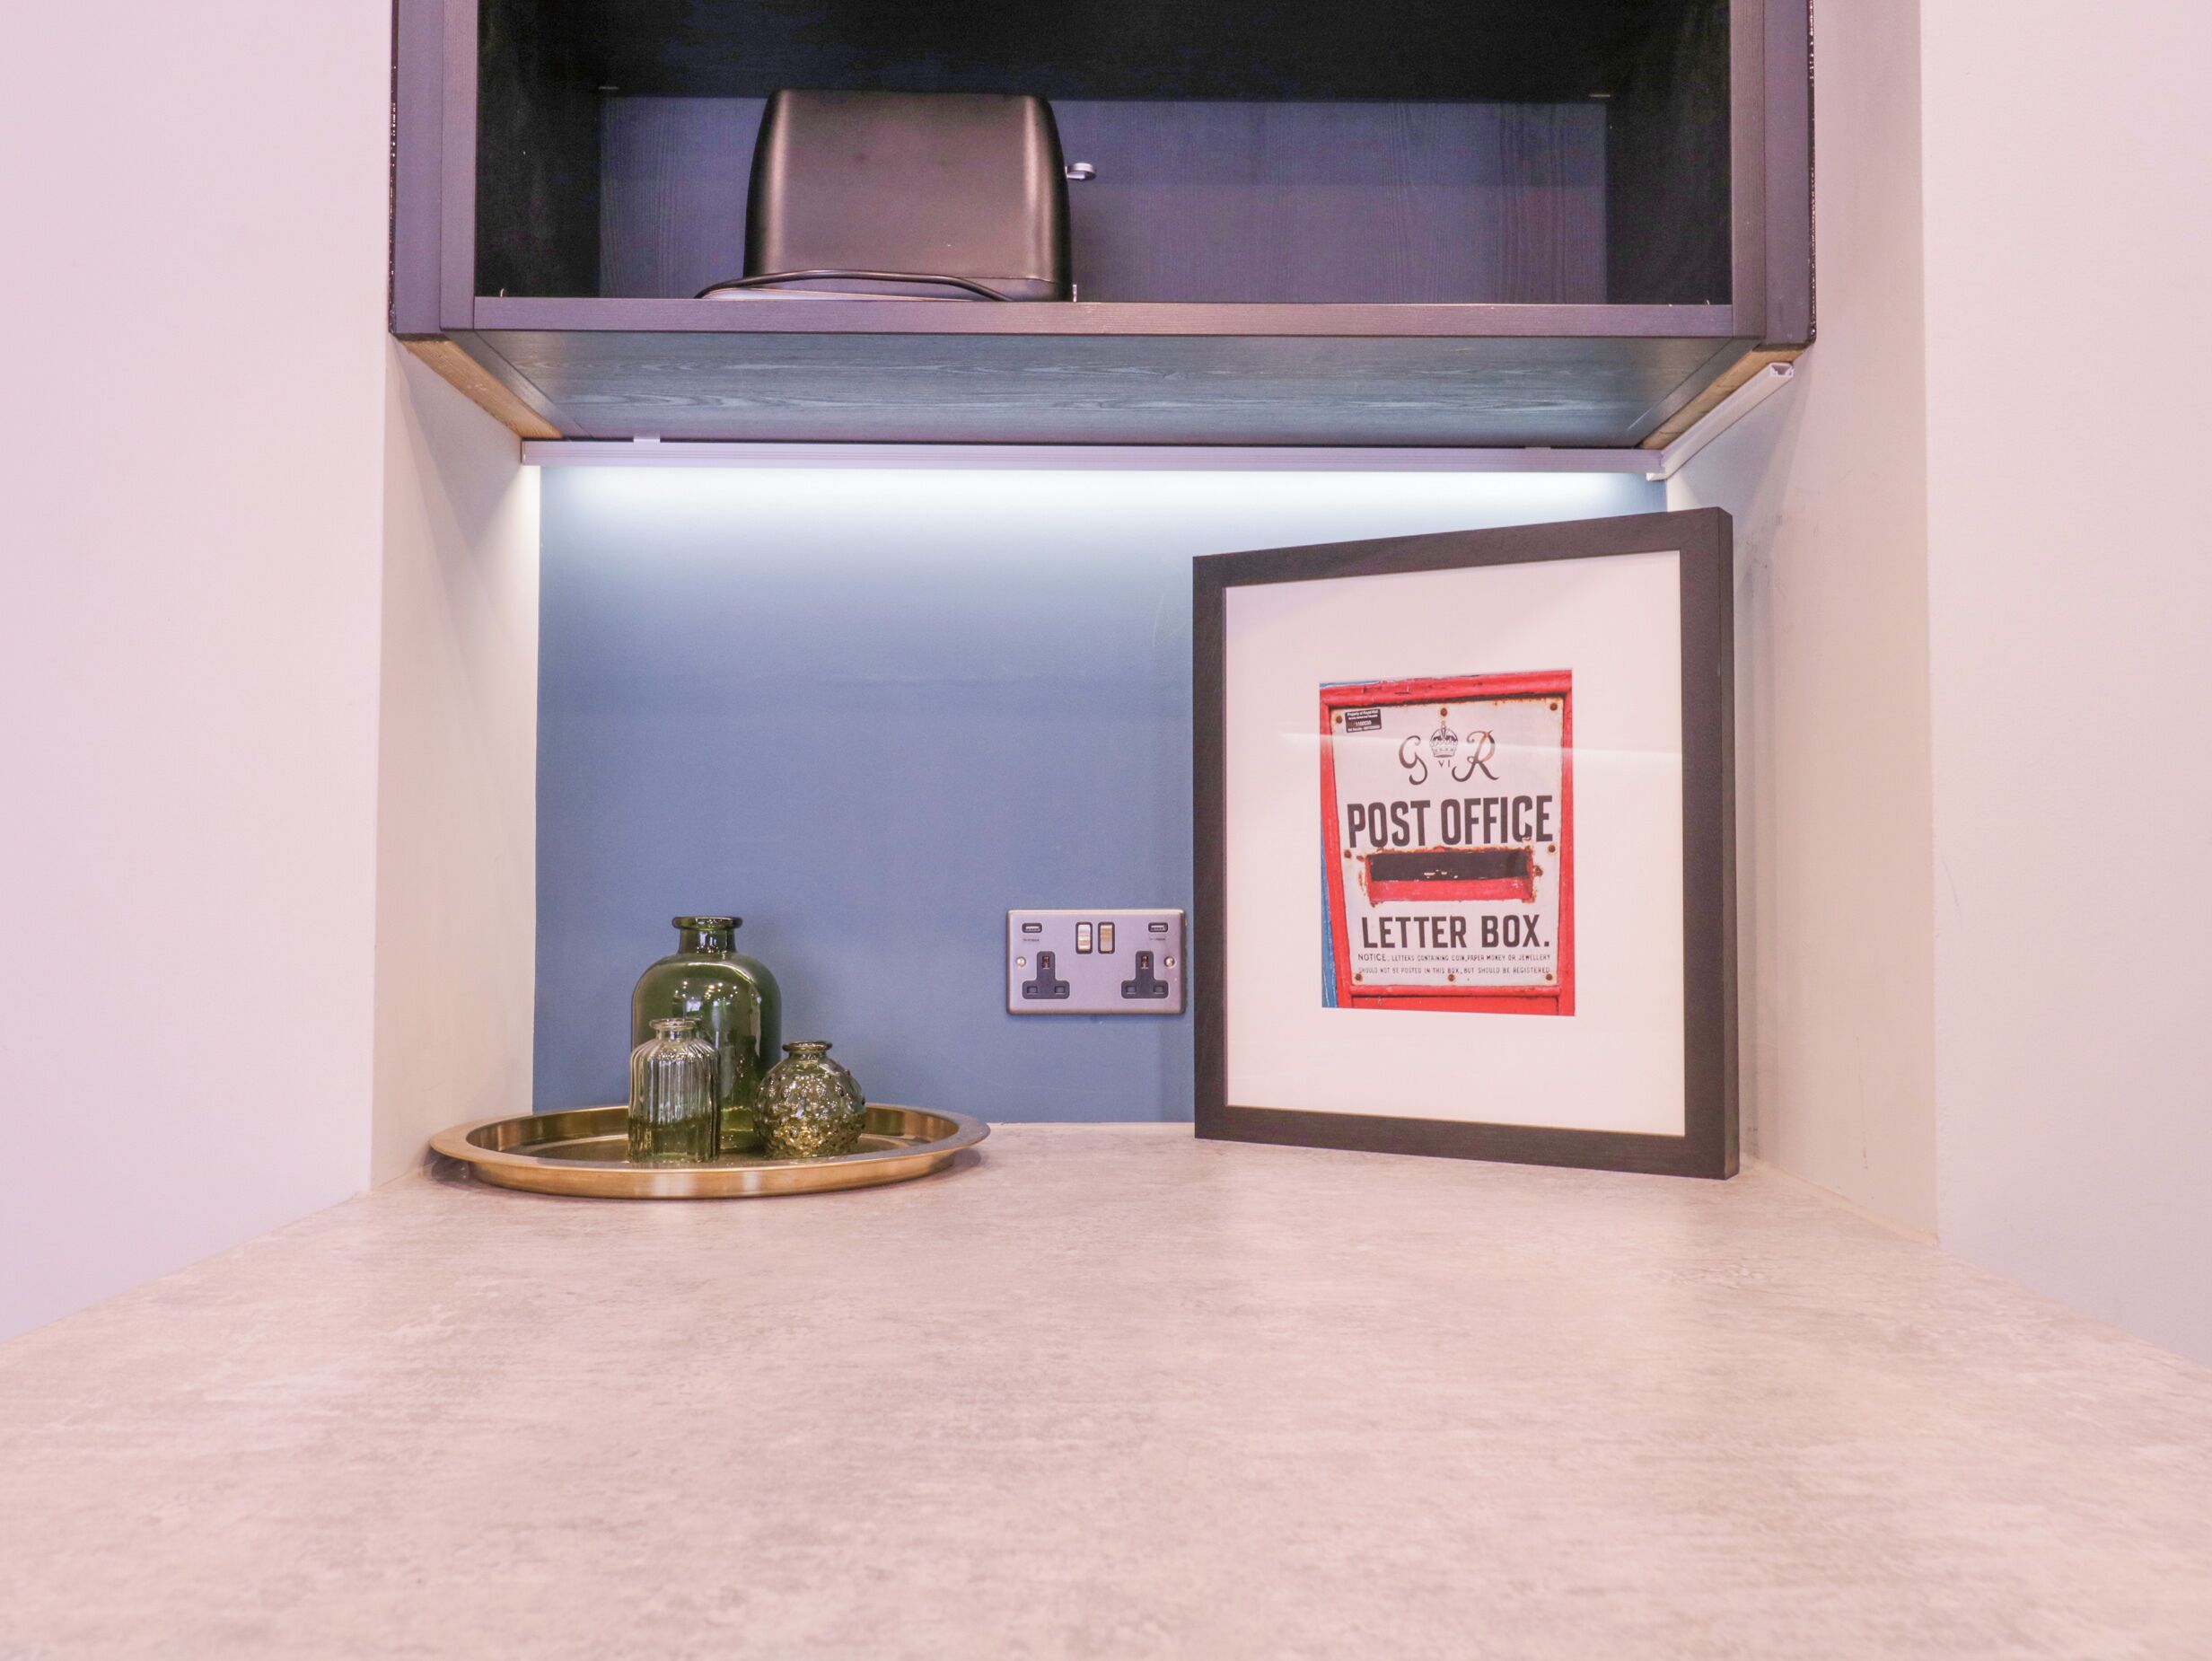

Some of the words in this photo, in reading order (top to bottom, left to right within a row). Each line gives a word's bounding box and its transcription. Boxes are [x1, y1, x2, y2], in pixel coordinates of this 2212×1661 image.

[1438, 760, 1451, 768] VI
[1347, 800, 1431, 848] POST
[1441, 795, 1553, 846] OFFICE
[1362, 916, 1467, 948] LETTER
[1481, 914, 1550, 947] BOX.
